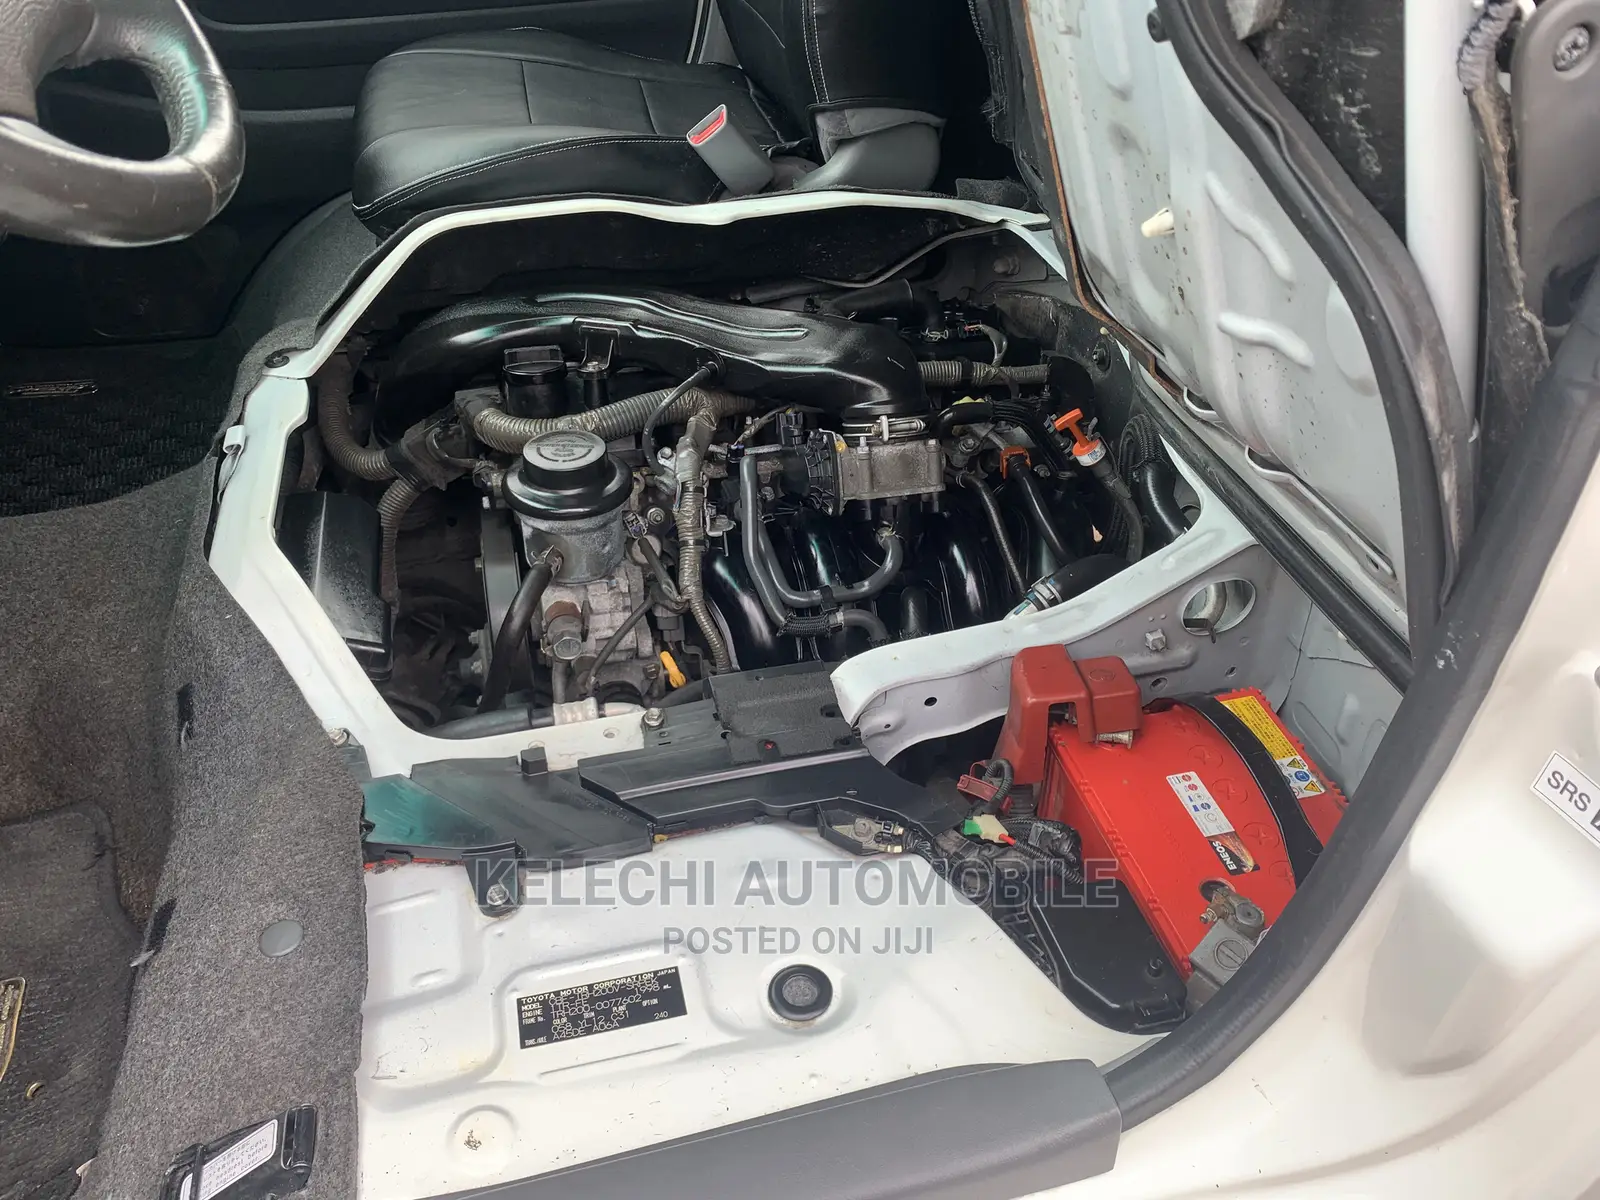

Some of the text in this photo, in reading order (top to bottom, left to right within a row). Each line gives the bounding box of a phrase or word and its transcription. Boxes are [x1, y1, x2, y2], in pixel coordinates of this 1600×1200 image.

[1547, 770, 1592, 812] SRS
[1212, 840, 1238, 871] ENEOS
[521, 968, 676, 1004] TOYOTA MOTOR CORPORATION JAPAN
[522, 1009, 543, 1018] ENGINE
[635, 982, 660, 995] 1998
[521, 1003, 543, 1012] MODEL
[653, 1011, 668, 1020] 240
